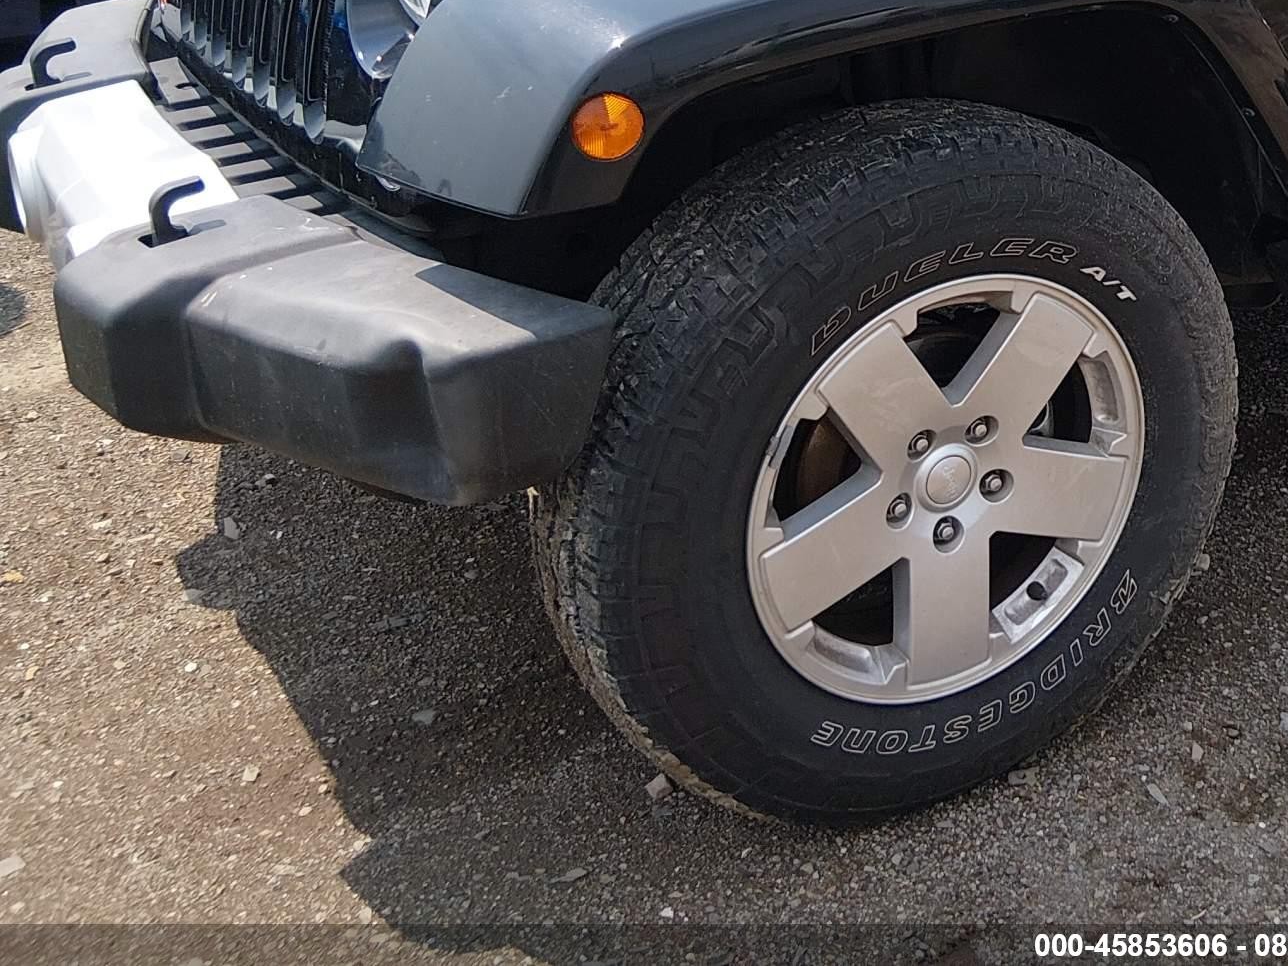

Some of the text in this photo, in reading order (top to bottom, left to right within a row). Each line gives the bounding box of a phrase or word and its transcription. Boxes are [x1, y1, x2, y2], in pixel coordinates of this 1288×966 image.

[811, 237, 1138, 357] DUELER A/T
[811, 569, 1138, 755] BRIDGESTONE
